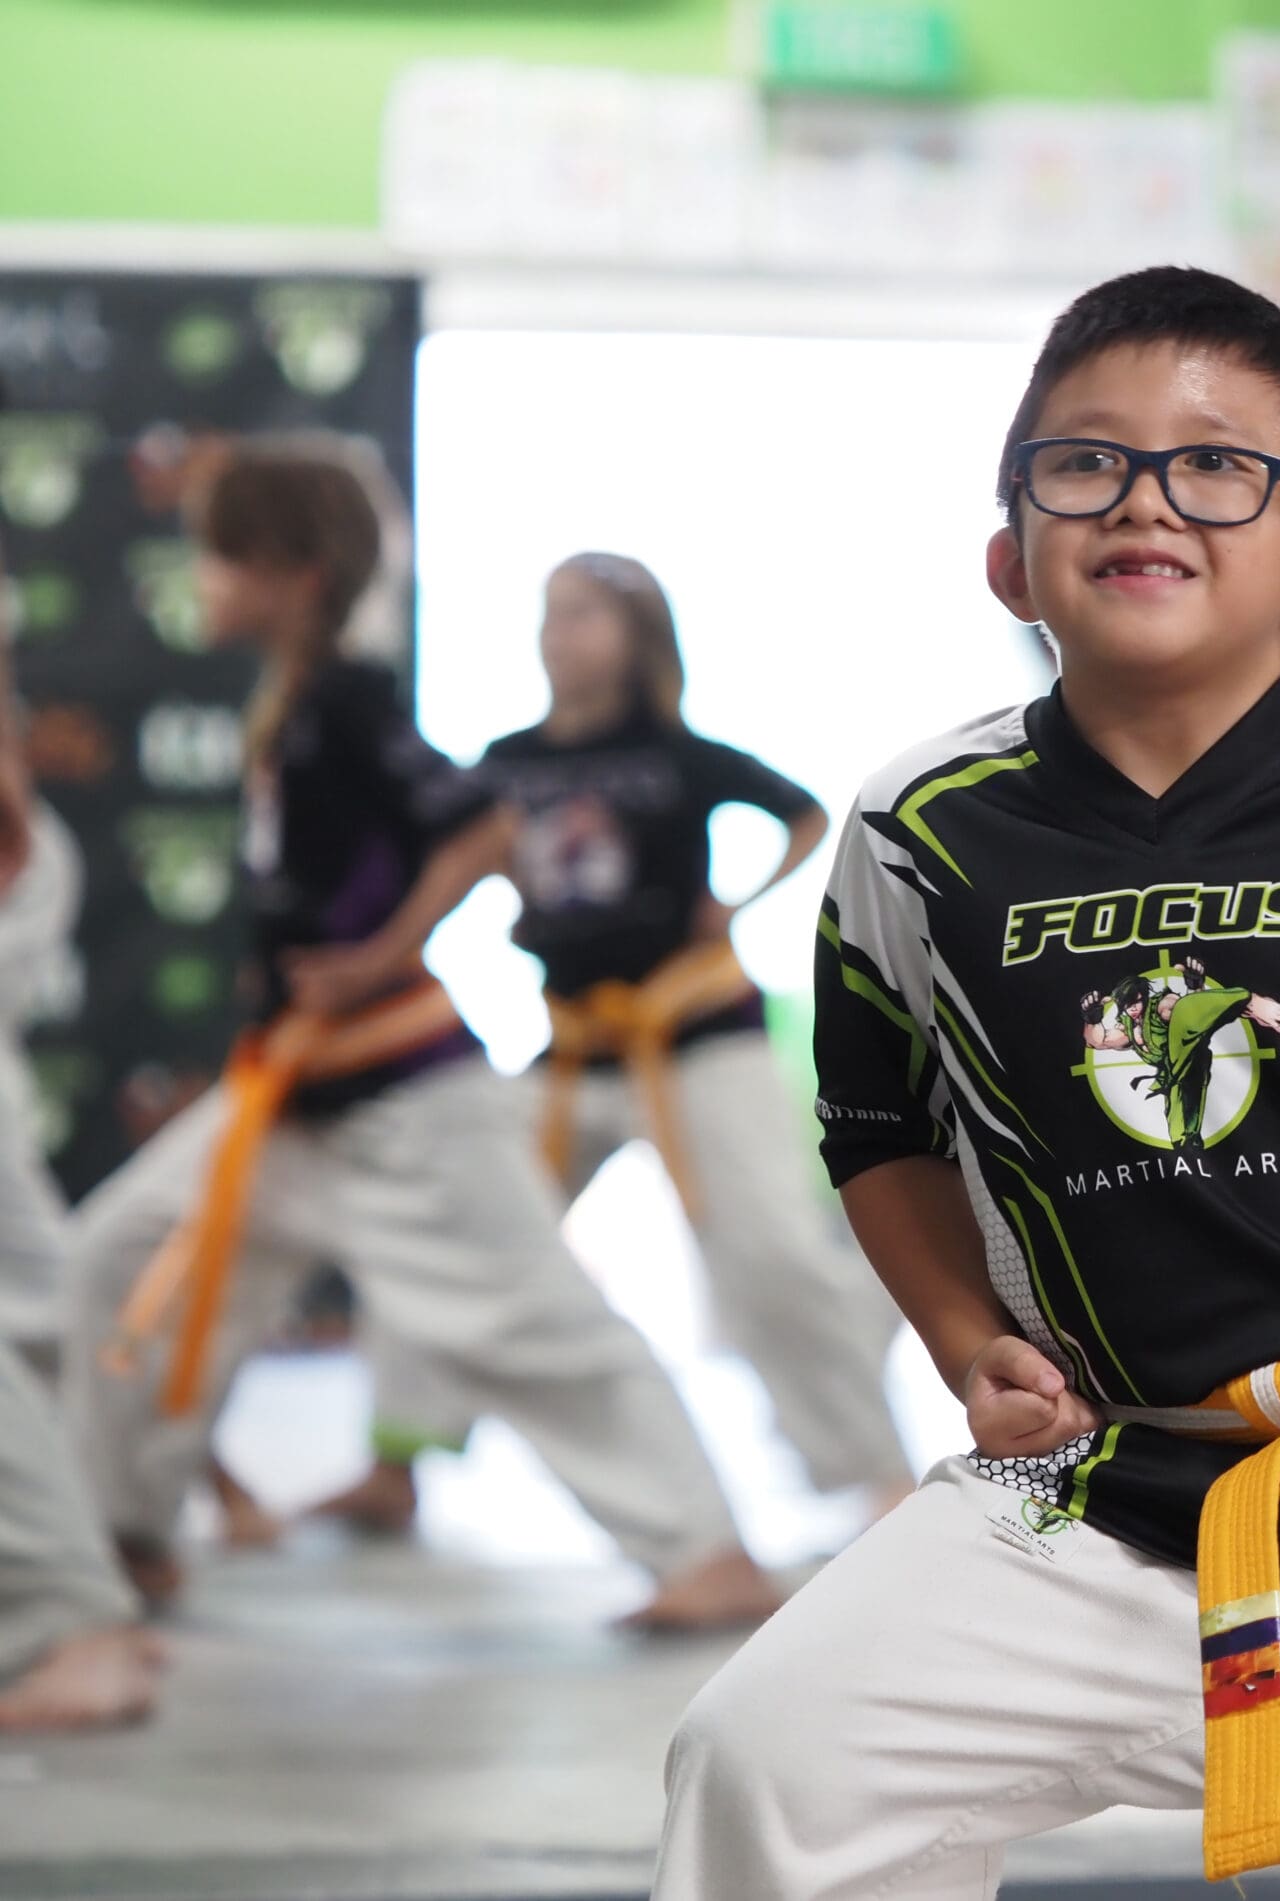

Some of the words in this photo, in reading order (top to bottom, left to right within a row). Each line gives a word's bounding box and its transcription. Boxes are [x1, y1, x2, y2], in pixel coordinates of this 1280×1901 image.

[1065, 1156, 1213, 1197] MARTIAL
[1001, 1515, 1034, 1540] MARTIAL
[1037, 1540, 1055, 1555] ARTS
